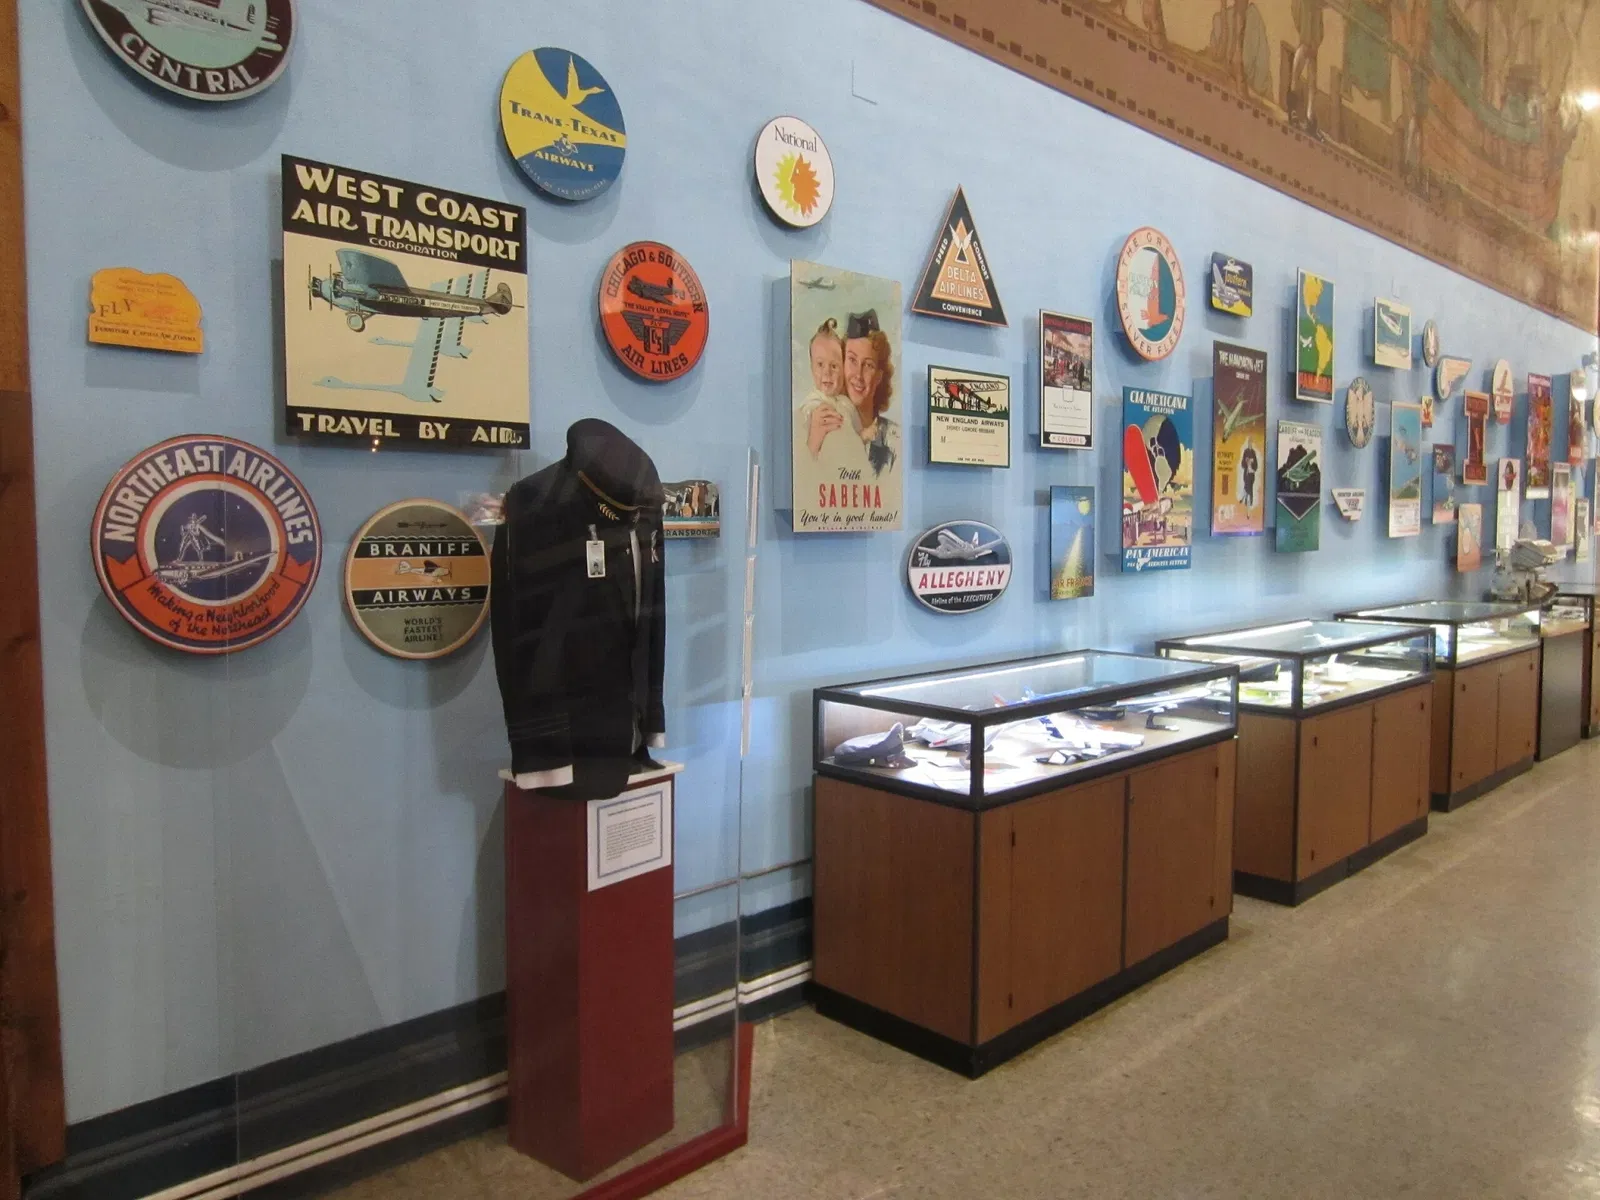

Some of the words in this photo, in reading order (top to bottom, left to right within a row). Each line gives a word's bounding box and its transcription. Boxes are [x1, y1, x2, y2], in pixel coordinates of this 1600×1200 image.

[120, 32, 260, 93] CENTRAL
[774, 124, 818, 153] National
[534, 150, 595, 173] AIRWAYS
[295, 164, 403, 209] WEST
[416, 192, 518, 232] COAST
[291, 199, 358, 231] AIR
[361, 212, 520, 261] TRANSPORT
[369, 237, 458, 260] CORPORATION
[935, 237, 949, 265] SPEED
[972, 240, 990, 280] COMFORT
[1121, 237, 1139, 268] THE
[1146, 231, 1182, 284] GREAT
[606, 248, 647, 298] CHICAGO
[648, 251, 656, 262] &
[658, 250, 704, 314] SOUTHERN
[947, 265, 977, 283] DELTA
[940, 280, 984, 302] AIRLINES
[100, 298, 134, 317] FLY
[941, 302, 983, 317] CONVENIENCE
[1121, 301, 1152, 354] SILVER
[621, 344, 646, 369] AIR
[650, 352, 689, 374] LINES
[297, 412, 400, 437] TRAVEL
[418, 421, 450, 440] BY
[952, 417, 979, 425] ENGLAND
[981, 419, 1005, 428] AIRWAYS
[838, 466, 862, 480] With
[104, 445, 225, 542] NORTHEAST
[227, 450, 314, 545] AIRLINES
[818, 483, 882, 508] SABENA
[800, 508, 830, 526] You're
[833, 511, 842, 523] in
[846, 512, 865, 525] good
[869, 510, 898, 523] hands!
[370, 543, 470, 556] BRANIFF
[918, 552, 932, 568] Fly
[1126, 549, 1143, 559] PAN
[1144, 546, 1189, 558] AMERICAN
[918, 570, 1005, 589] ALLEGHENY
[148, 580, 195, 621] Making
[195, 613, 204, 623] a
[372, 588, 471, 603] AIRWAYS
[948, 595, 954, 604] of
[962, 593, 993, 603] EXECUTIVES
[168, 618, 181, 633] of
[187, 622, 208, 636] the
[211, 608, 273, 636] Northeast
[404, 617, 443, 626] WORLD'S
[404, 625, 443, 634] FASTEST
